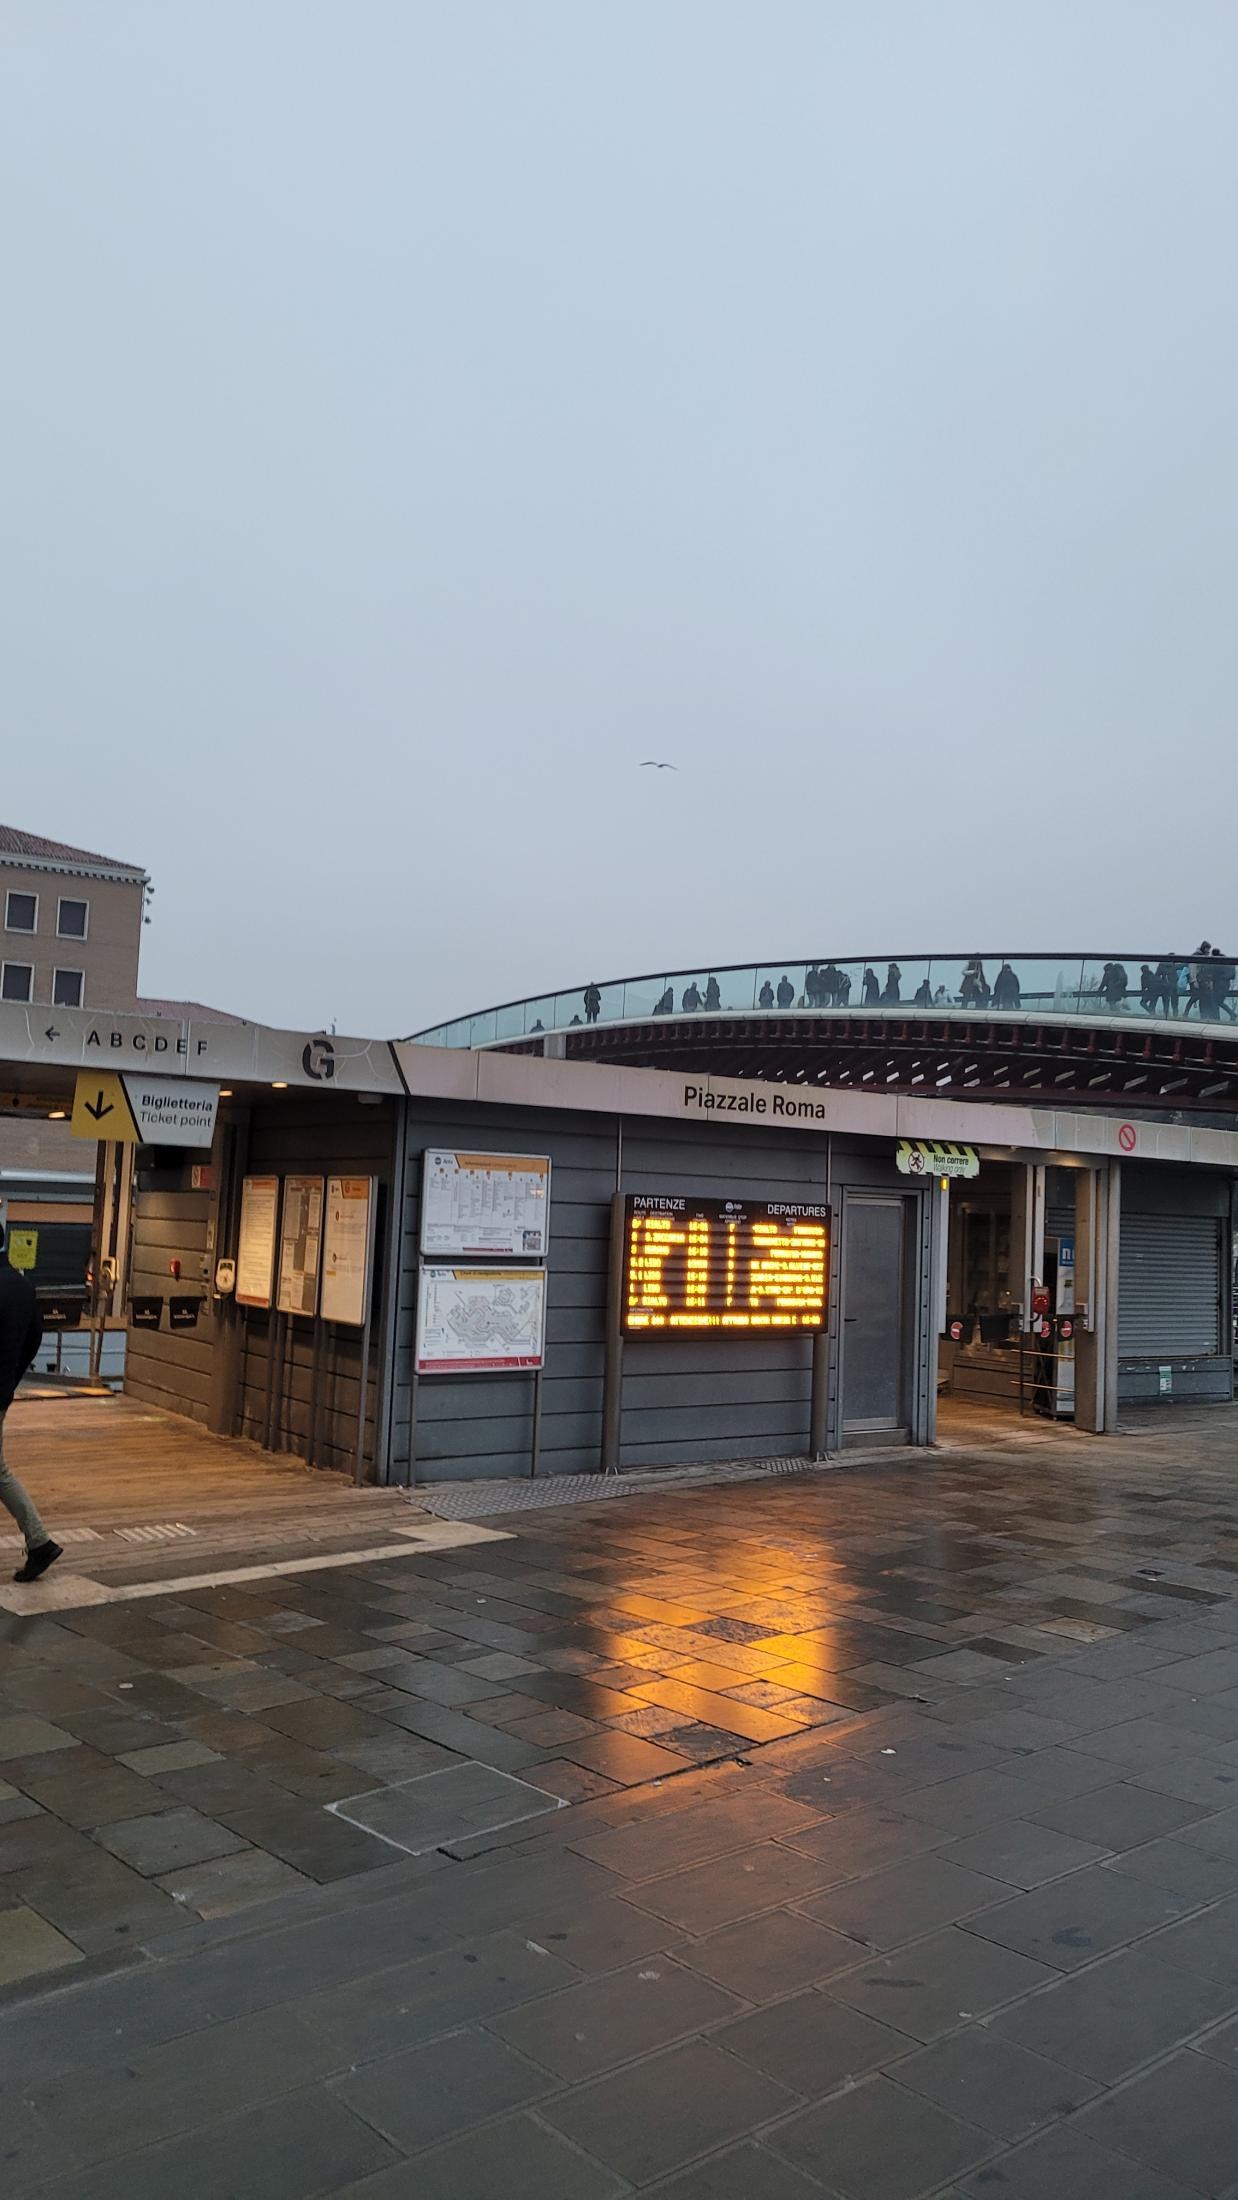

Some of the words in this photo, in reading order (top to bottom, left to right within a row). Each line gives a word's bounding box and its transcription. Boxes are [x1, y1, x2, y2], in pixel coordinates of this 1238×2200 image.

[87, 1030, 100, 1046] A
[110, 1032, 123, 1048] B
[133, 1034, 146, 1050] C
[154, 1036, 168, 1052] D
[176, 1039, 188, 1055] E
[197, 1041, 208, 1056] F
[302, 1039, 335, 1080] G
[141, 1095, 213, 1112] Biglietteria
[684, 1086, 767, 1114] Piazzale
[773, 1095, 826, 1119] Roma
[140, 1112, 176, 1125] Ticket
[179, 1115, 212, 1128] point
[934, 1154, 946, 1164] Non
[946, 1157, 969, 1166] correre
[633, 1197, 686, 1210] PARTENZE
[767, 1204, 826, 1217] DEPARTURES
